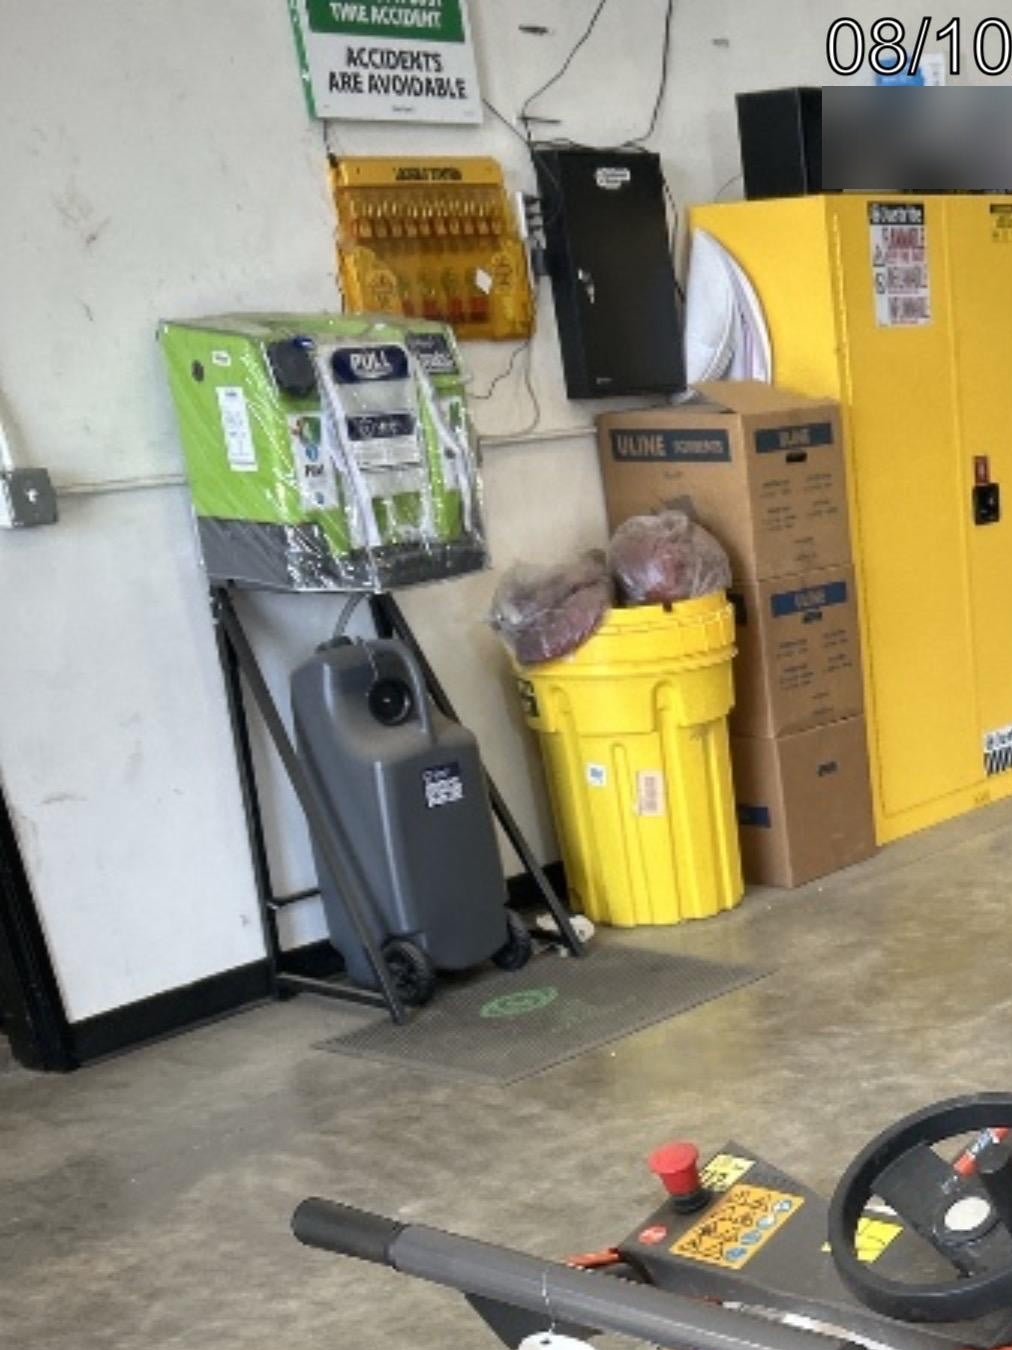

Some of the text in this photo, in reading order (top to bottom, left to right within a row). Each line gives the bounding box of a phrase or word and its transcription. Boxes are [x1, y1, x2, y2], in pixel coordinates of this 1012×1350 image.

[346, 46, 443, 73] ACCIDENTS
[328, 70, 468, 100] ARE AVOIDABLE
[616, 433, 667, 458] ULINE
